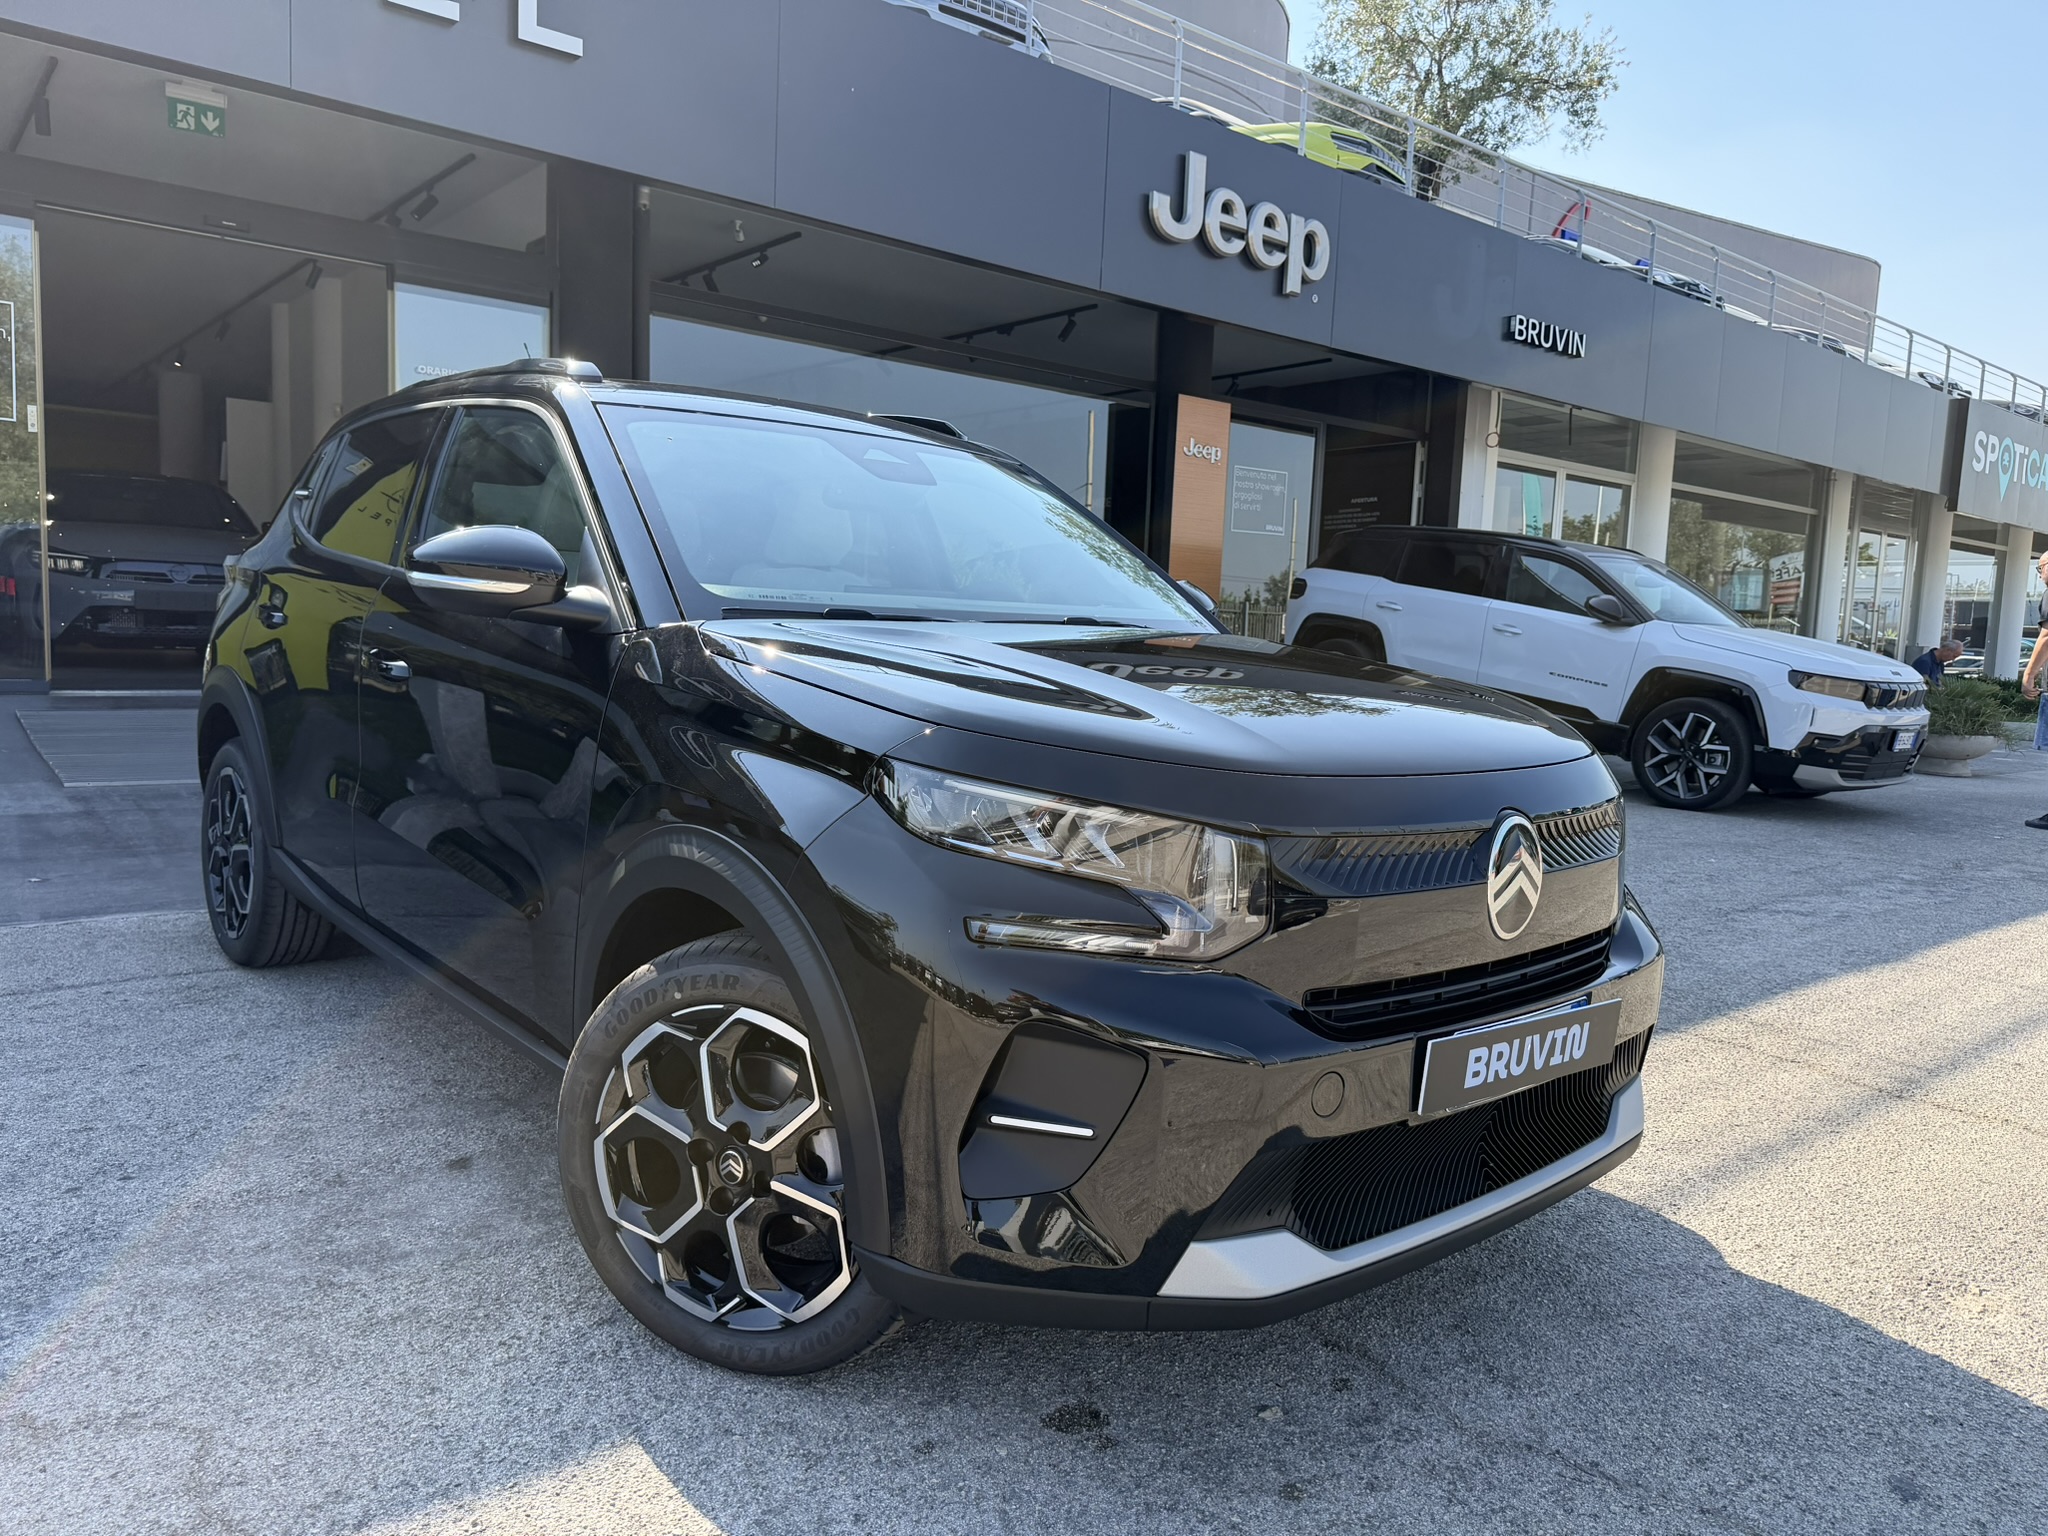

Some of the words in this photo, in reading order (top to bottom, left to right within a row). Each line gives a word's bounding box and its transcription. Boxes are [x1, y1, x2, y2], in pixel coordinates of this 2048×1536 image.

[1149, 150, 1330, 297] Jeep
[1513, 314, 1587, 358] BRUVIN
[1183, 437, 1222, 464] Jeep
[603, 973, 741, 1040] GOODYEAR
[1463, 1021, 1590, 1089] BRUVIN
